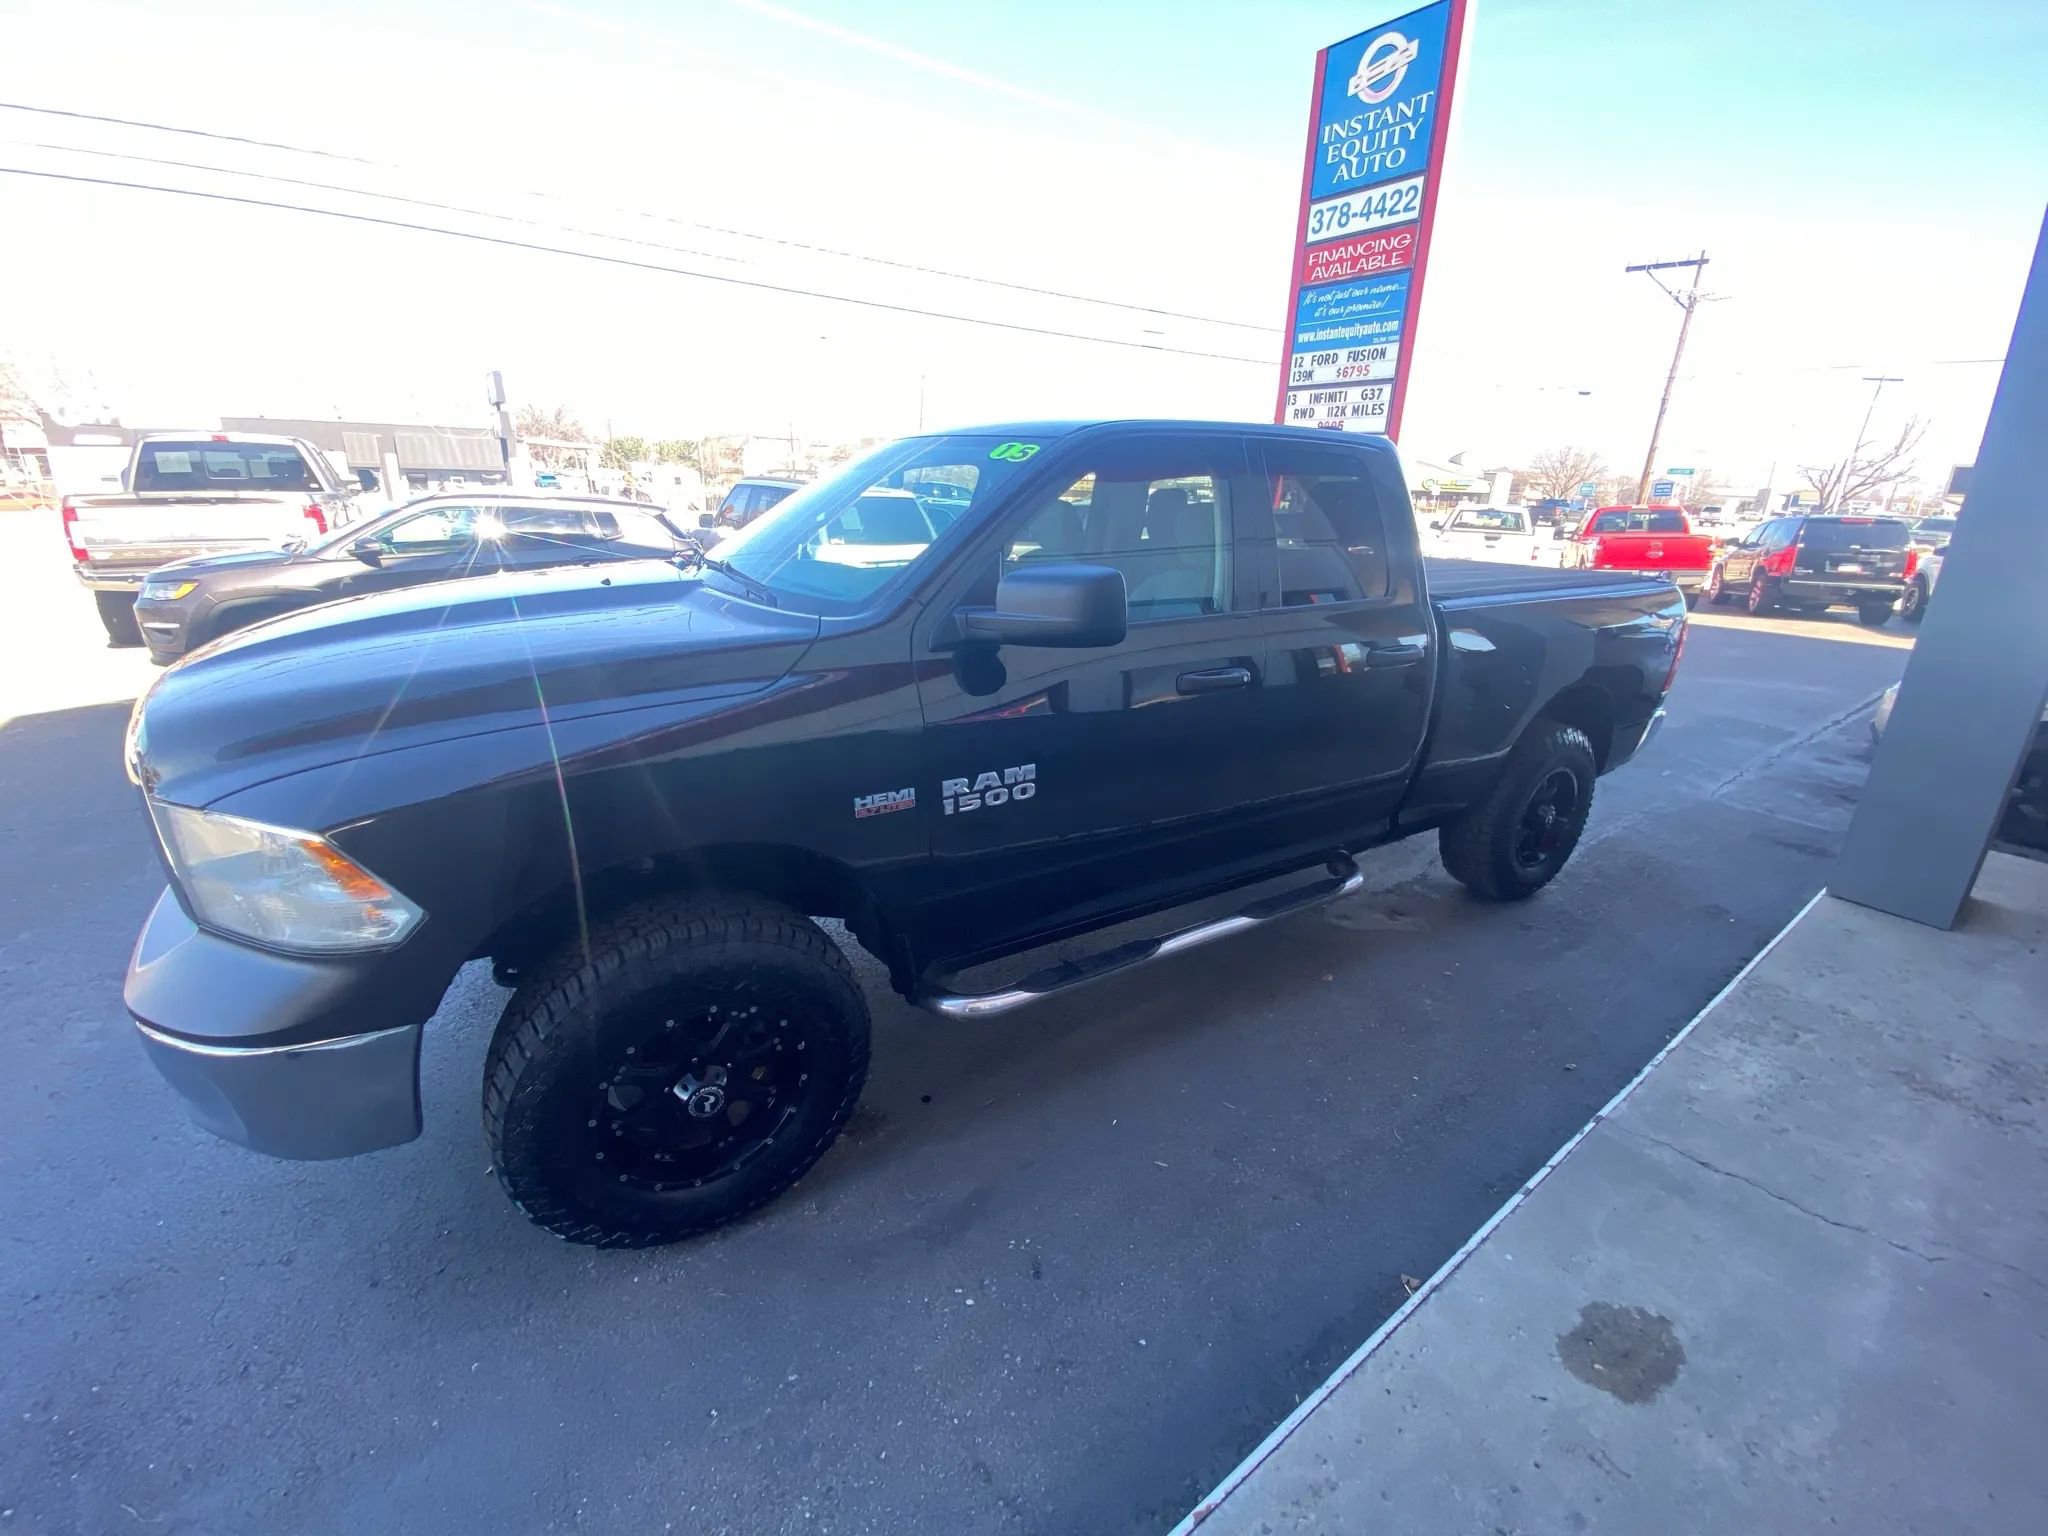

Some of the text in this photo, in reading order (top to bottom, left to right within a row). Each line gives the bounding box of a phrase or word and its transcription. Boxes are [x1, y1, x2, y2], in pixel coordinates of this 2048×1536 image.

[1322, 91, 1435, 144] INSTANT
[1326, 117, 1424, 165] EQUITY
[1332, 147, 1406, 184] AUTO
[1311, 184, 1419, 236] 378-4422
[1308, 233, 1412, 266] FINANCING
[1311, 251, 1405, 280] AVAILABLE
[1318, 290, 1334, 303] not
[1330, 288, 1351, 305] just
[1343, 295, 1390, 317] promise!
[1298, 320, 1399, 343] www.instantequityauto.com
[1294, 347, 1387, 368] 12 FORD FUSION
[1292, 364, 1371, 383] 139K $6795
[1287, 388, 1384, 406] 13 INFINITI G37
[1293, 403, 1385, 419] RWD 112K MILES
[942, 763, 1036, 797] RAM
[854, 787, 915, 809] HEMI
[942, 782, 1036, 816] 1500
